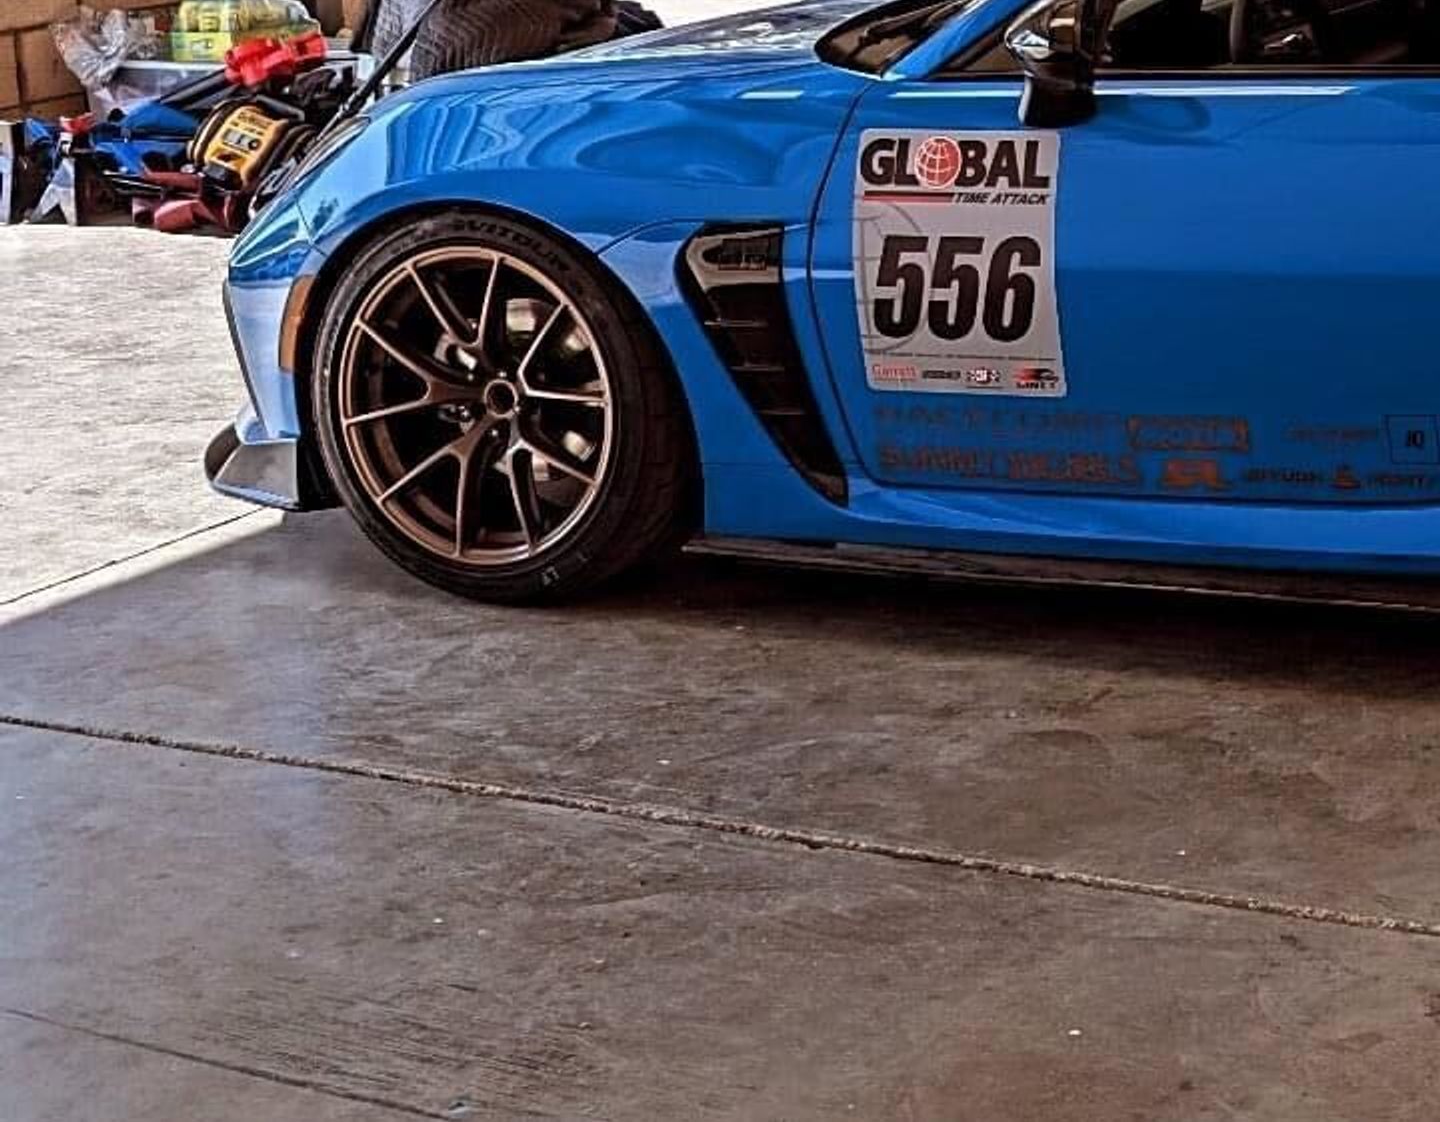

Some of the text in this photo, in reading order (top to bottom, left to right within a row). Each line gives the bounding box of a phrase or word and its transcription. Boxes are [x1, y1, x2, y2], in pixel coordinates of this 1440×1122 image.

[860, 136, 1050, 189] GLOBAL
[955, 192, 1049, 205] TIME ATTACK
[873, 234, 1042, 343] 556
